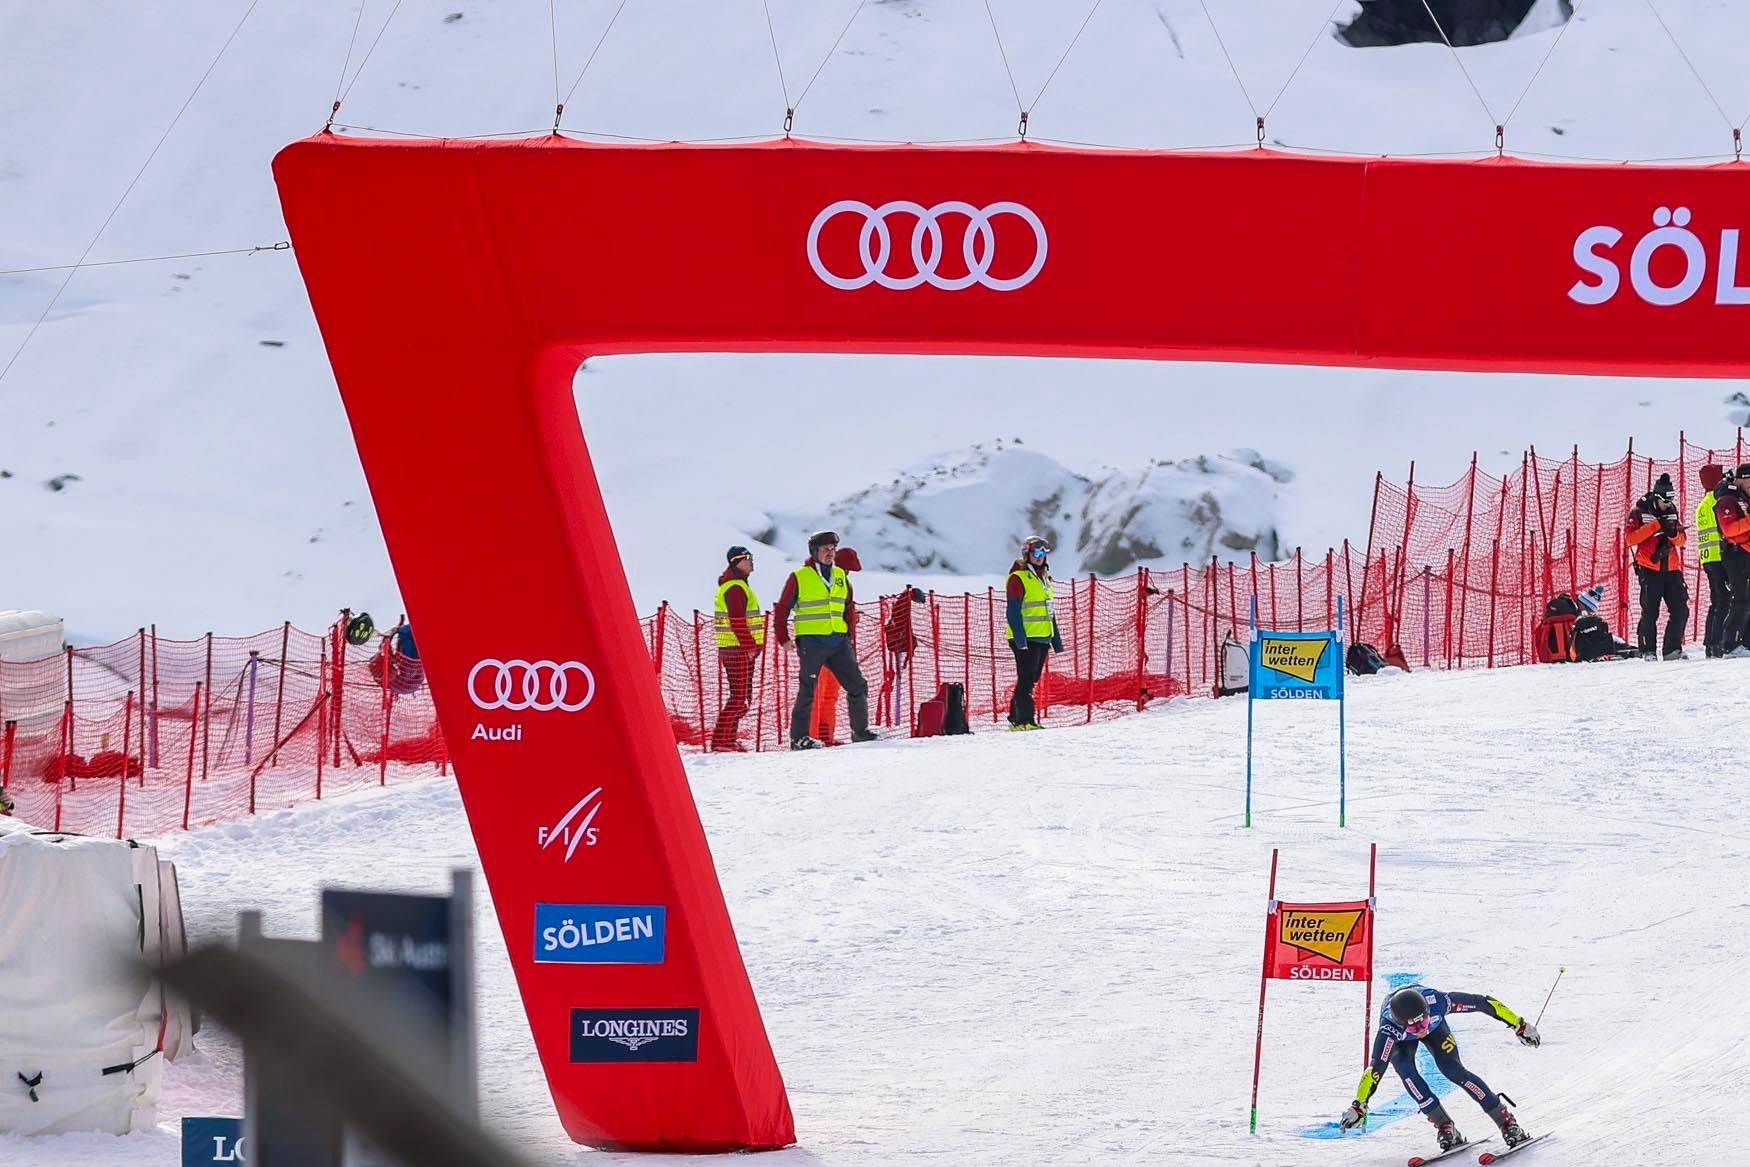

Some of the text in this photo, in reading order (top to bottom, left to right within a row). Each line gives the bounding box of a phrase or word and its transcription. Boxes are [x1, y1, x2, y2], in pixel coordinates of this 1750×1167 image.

[1265, 640, 1298, 655] inter
[1268, 655, 1315, 667] wetten
[1270, 687, 1323, 699] SÖLDEN
[471, 723, 522, 741] Audi
[1285, 911, 1326, 929] inter
[543, 915, 653, 951] SÖLDEN
[1289, 929, 1345, 942] wetten
[1290, 964, 1354, 980] SÖLDEN
[582, 1019, 688, 1037] LONGINES
